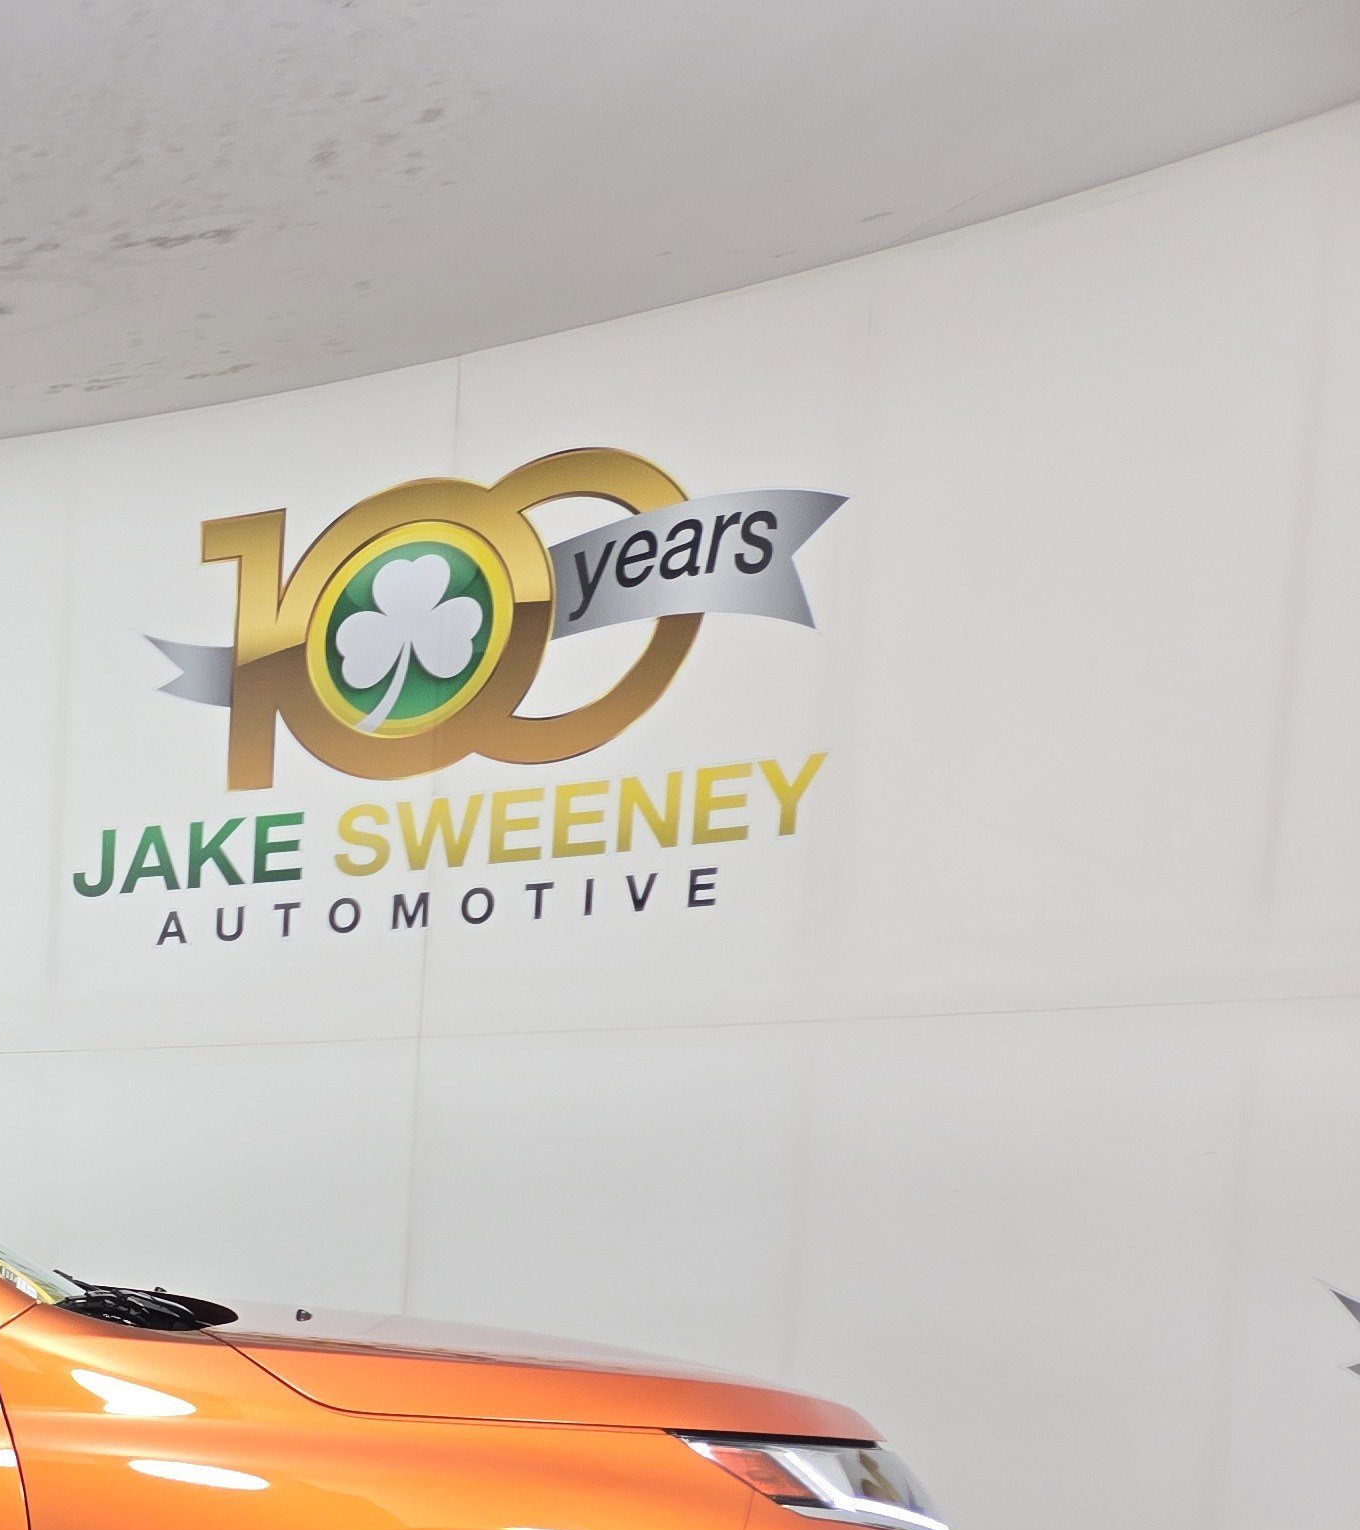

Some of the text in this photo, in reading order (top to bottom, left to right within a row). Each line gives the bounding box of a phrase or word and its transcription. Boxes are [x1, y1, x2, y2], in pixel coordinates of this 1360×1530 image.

[568, 510, 779, 622] years
[73, 751, 829, 898] JAKE SWEENEY
[156, 866, 720, 947] AUTOMOTIVE
